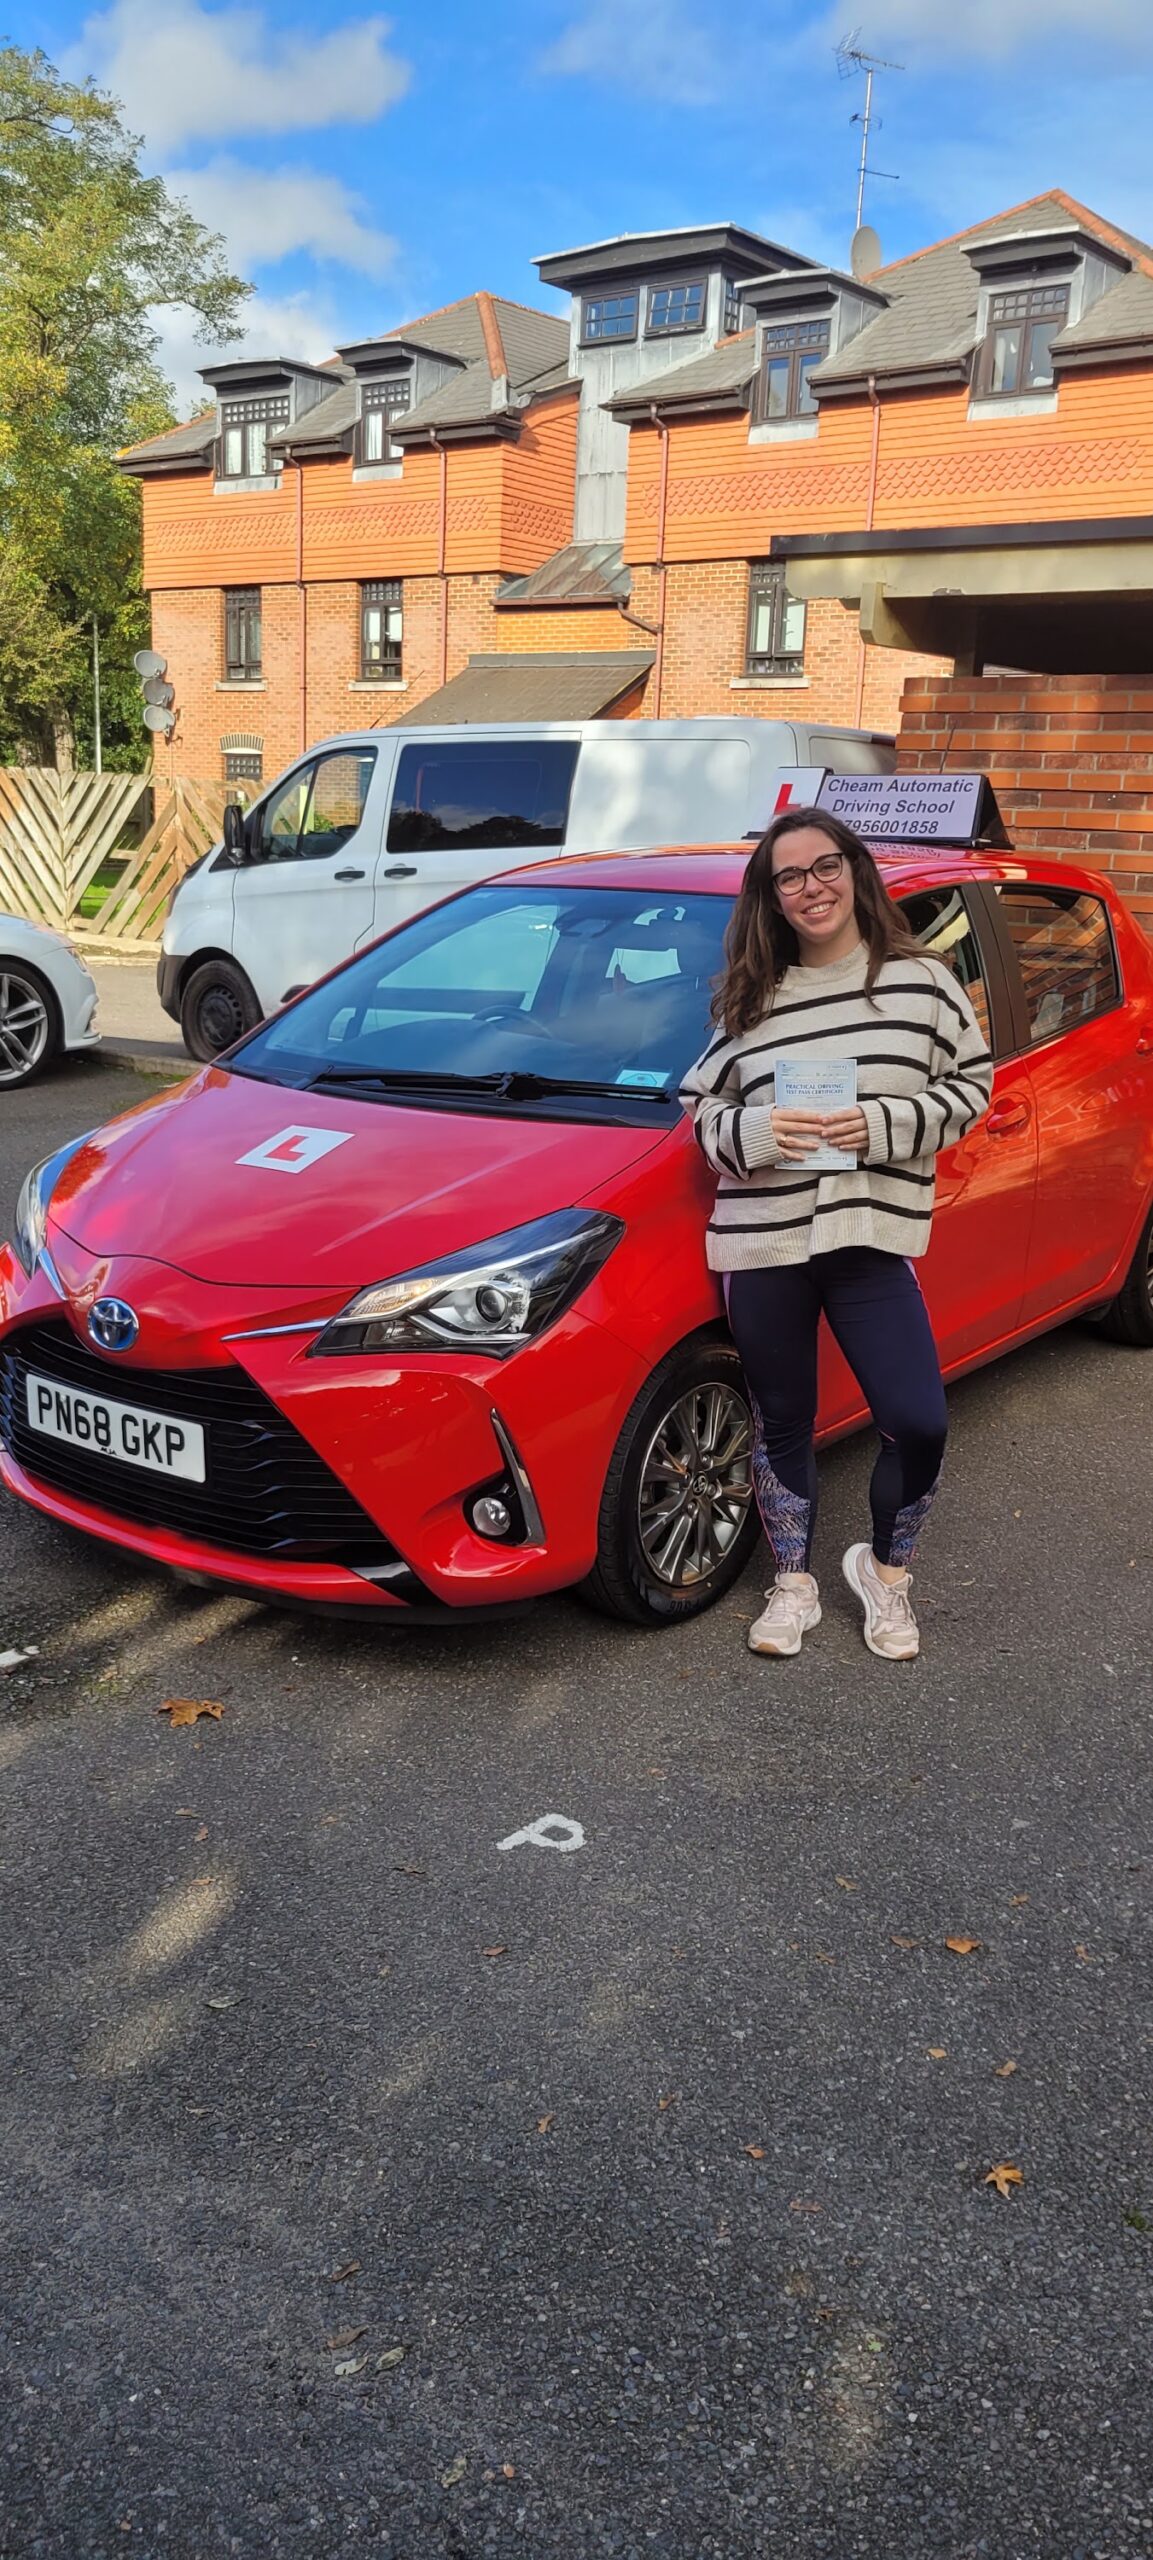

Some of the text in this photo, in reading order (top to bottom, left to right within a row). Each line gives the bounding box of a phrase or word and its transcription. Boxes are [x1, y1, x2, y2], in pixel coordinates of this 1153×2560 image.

[828, 779, 974, 793] Cheam Automatic
[832, 799, 955, 816] Driving School
[843, 819, 939, 834] 7956001858
[264, 1135, 309, 1162] L
[37, 1384, 185, 1466] PN68 GKP
